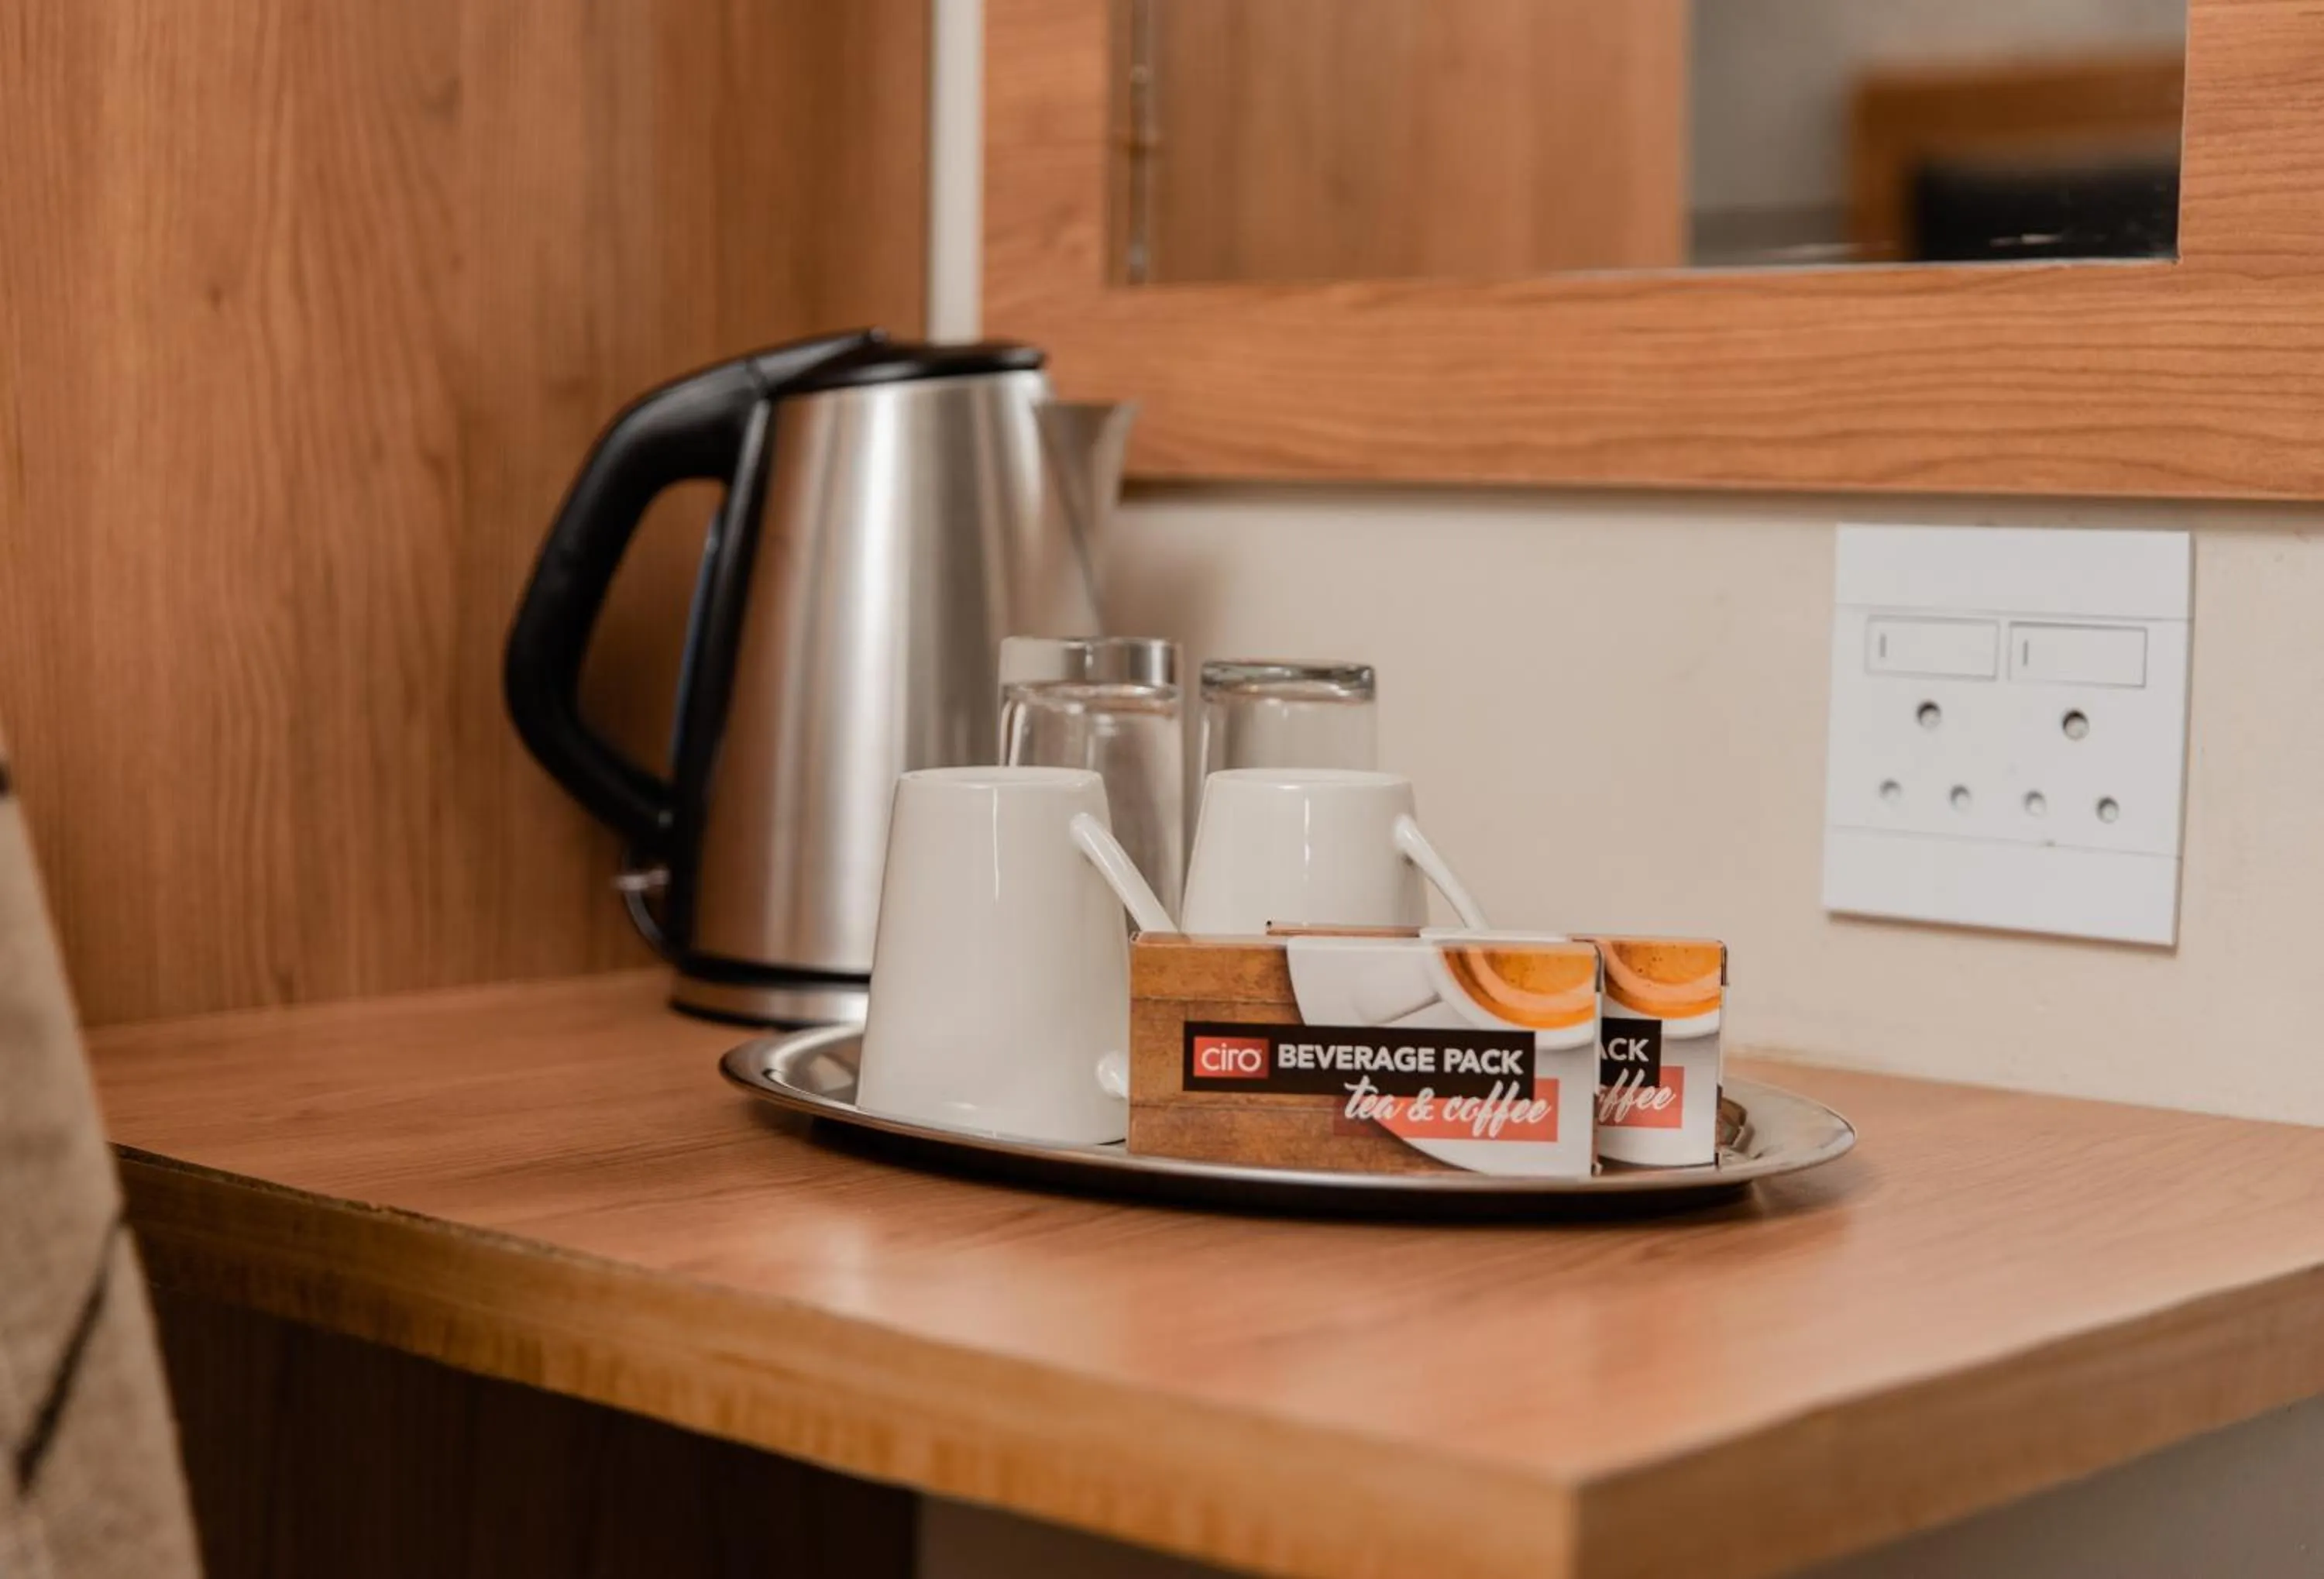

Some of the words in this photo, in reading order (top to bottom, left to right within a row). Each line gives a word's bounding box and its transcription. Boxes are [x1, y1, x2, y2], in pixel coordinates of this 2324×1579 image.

[1201, 1043, 1261, 1073] ciro
[1277, 1044, 1435, 1073] BEVERAGE
[1443, 1048, 1524, 1075] PACK
[1344, 1075, 1404, 1119] tea
[1407, 1087, 1435, 1121] &
[1442, 1080, 1552, 1137] coffee
